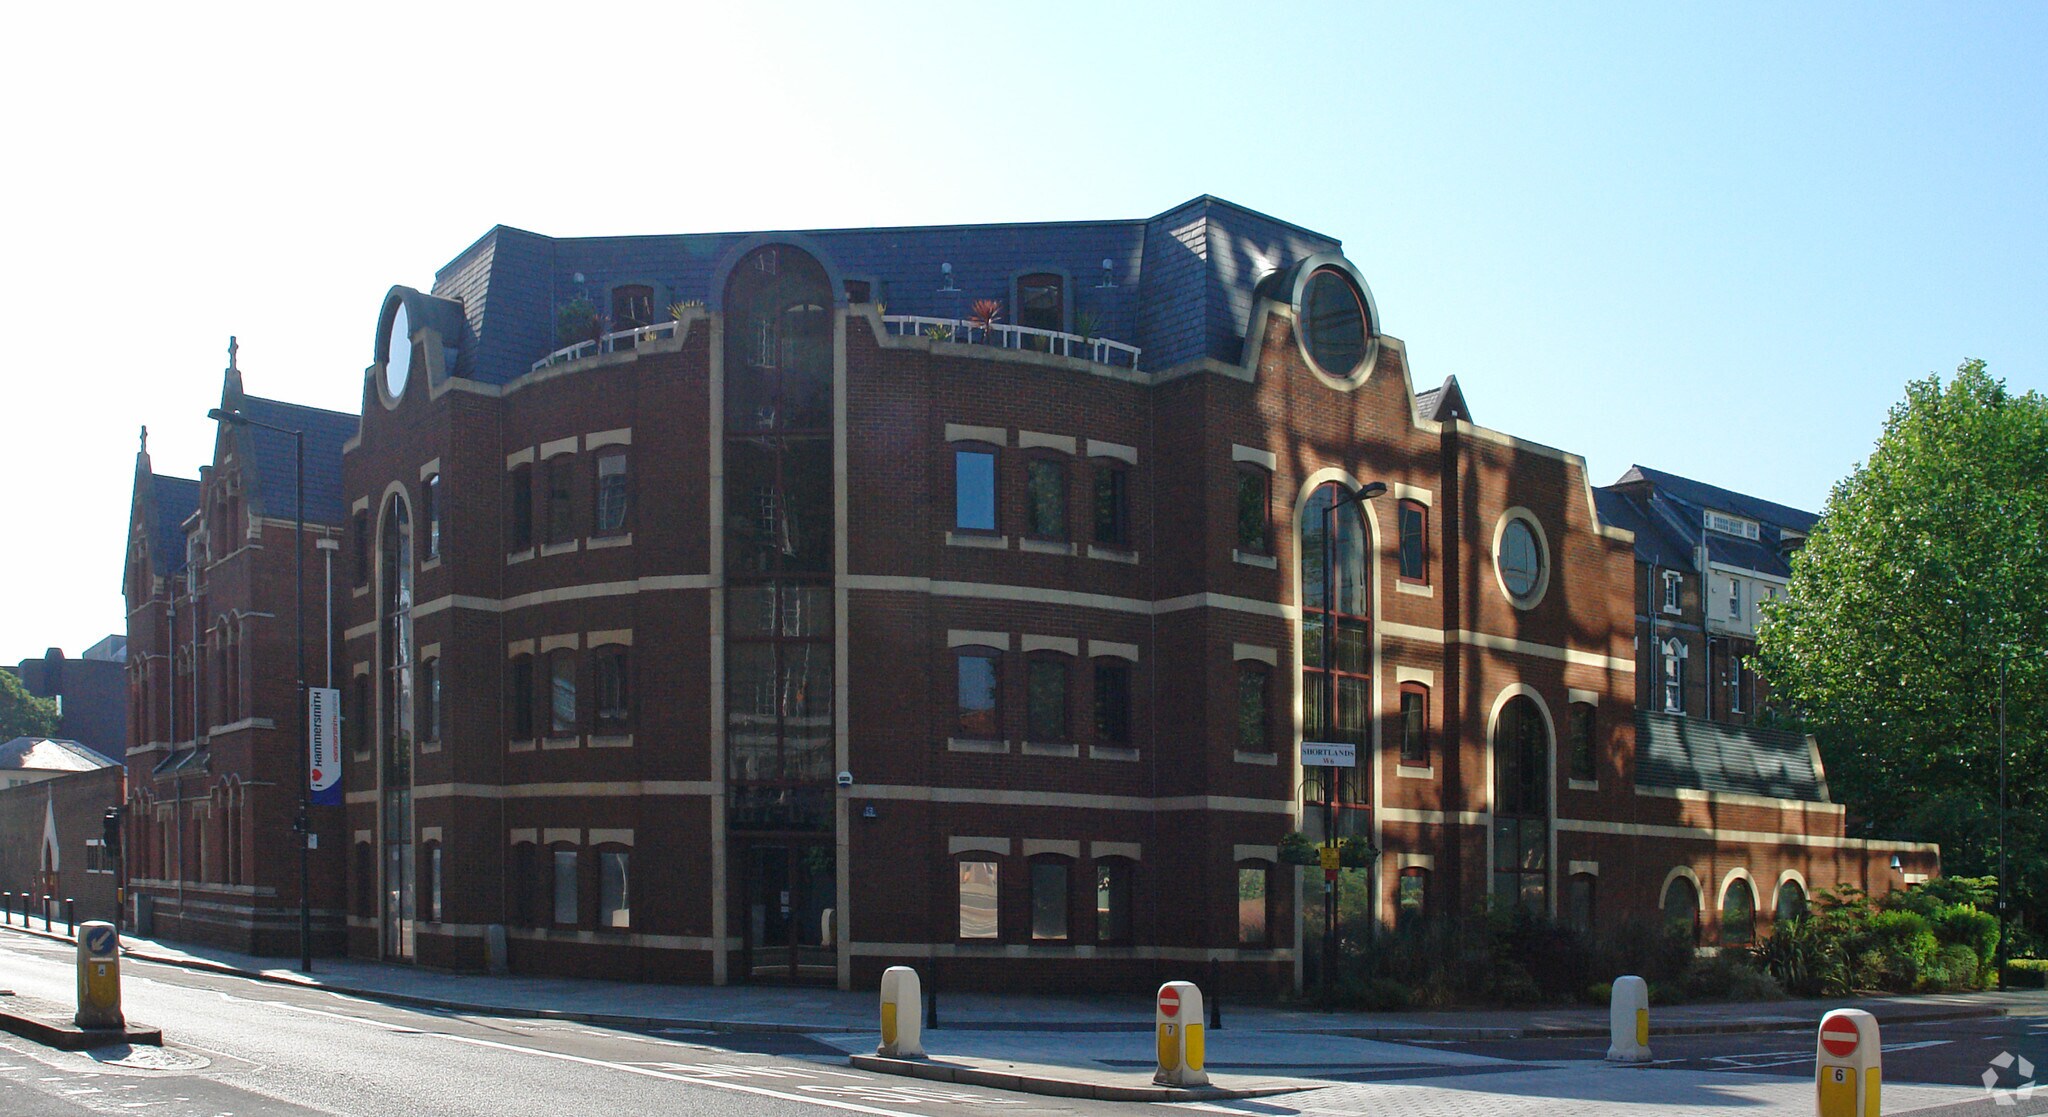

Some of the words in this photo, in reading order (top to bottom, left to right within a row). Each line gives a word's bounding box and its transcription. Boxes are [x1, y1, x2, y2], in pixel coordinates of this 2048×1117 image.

[1302, 748, 1354, 756] SHORTLANDS
[1168, 1025, 1173, 1034] 7
[1835, 1069, 1844, 1082] 6
